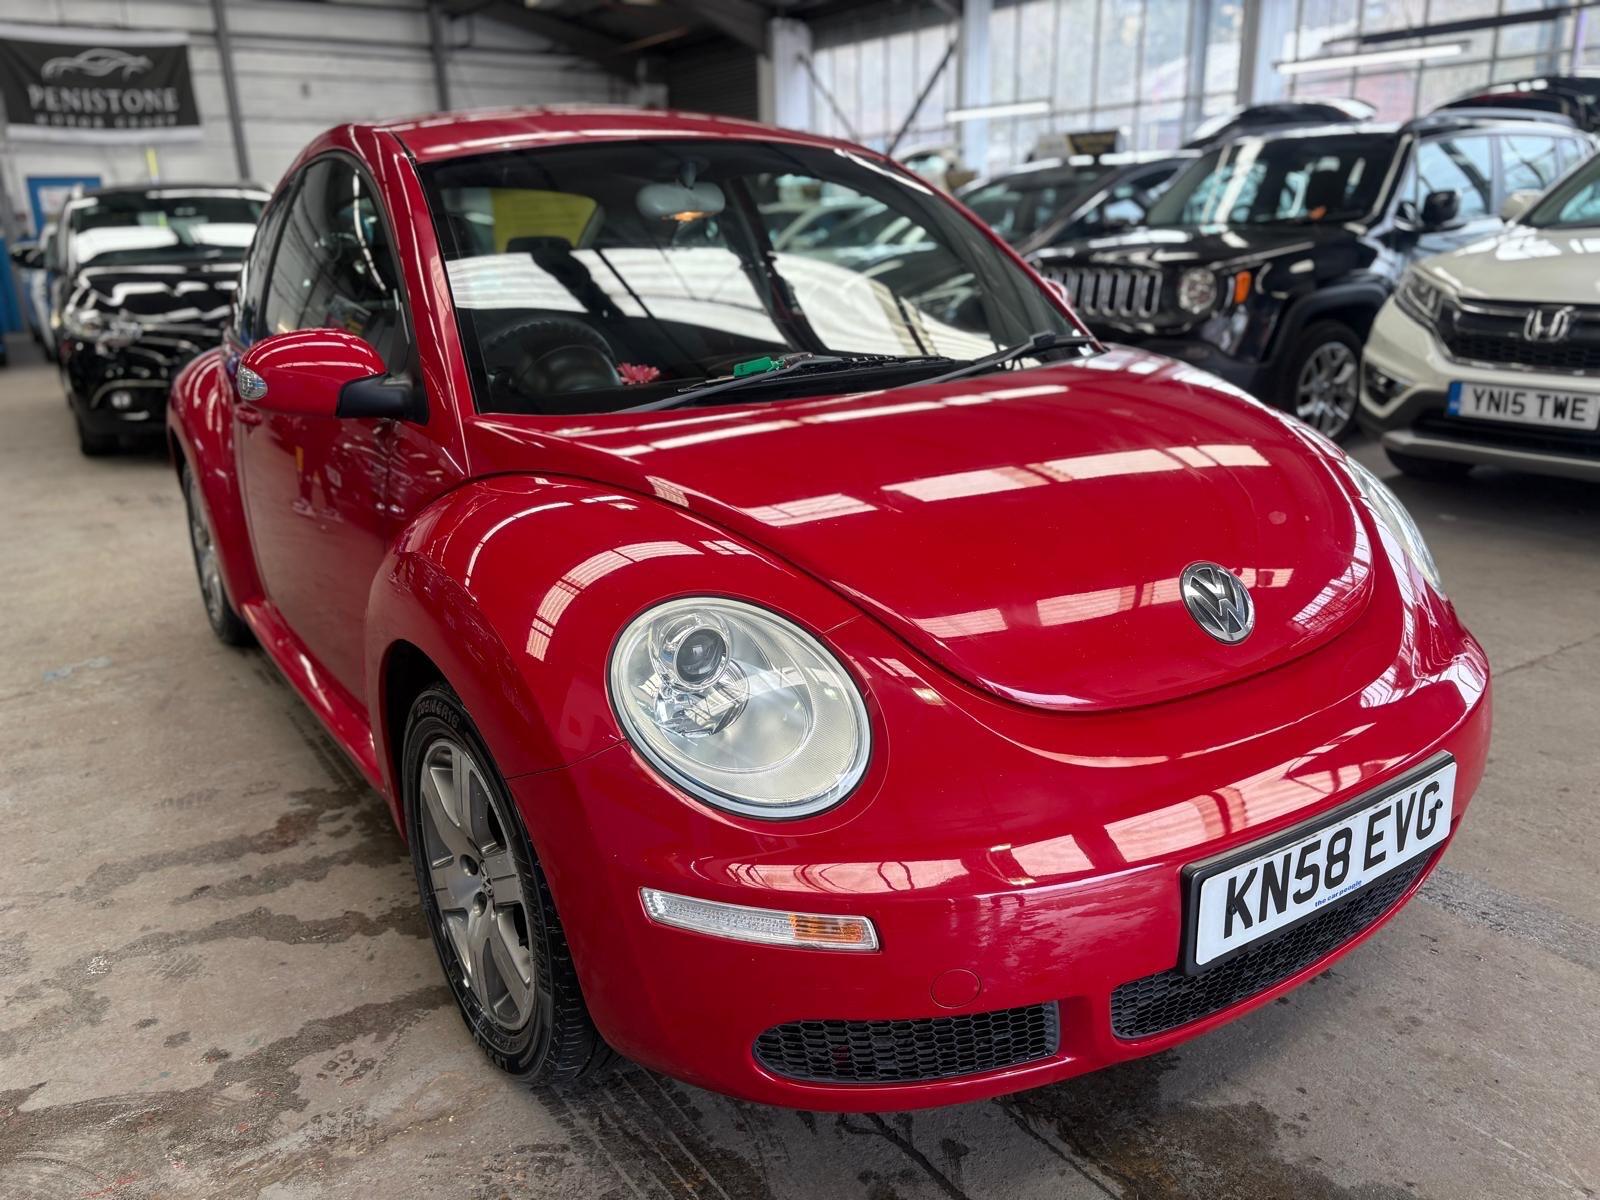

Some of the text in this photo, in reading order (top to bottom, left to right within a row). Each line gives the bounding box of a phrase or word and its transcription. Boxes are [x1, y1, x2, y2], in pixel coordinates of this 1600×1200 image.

[27, 83, 180, 114] PENISTONE
[1473, 387, 1588, 422] YN15 TWE
[1223, 780, 1441, 940] KN58 EVG
[1314, 898, 1327, 907] the
